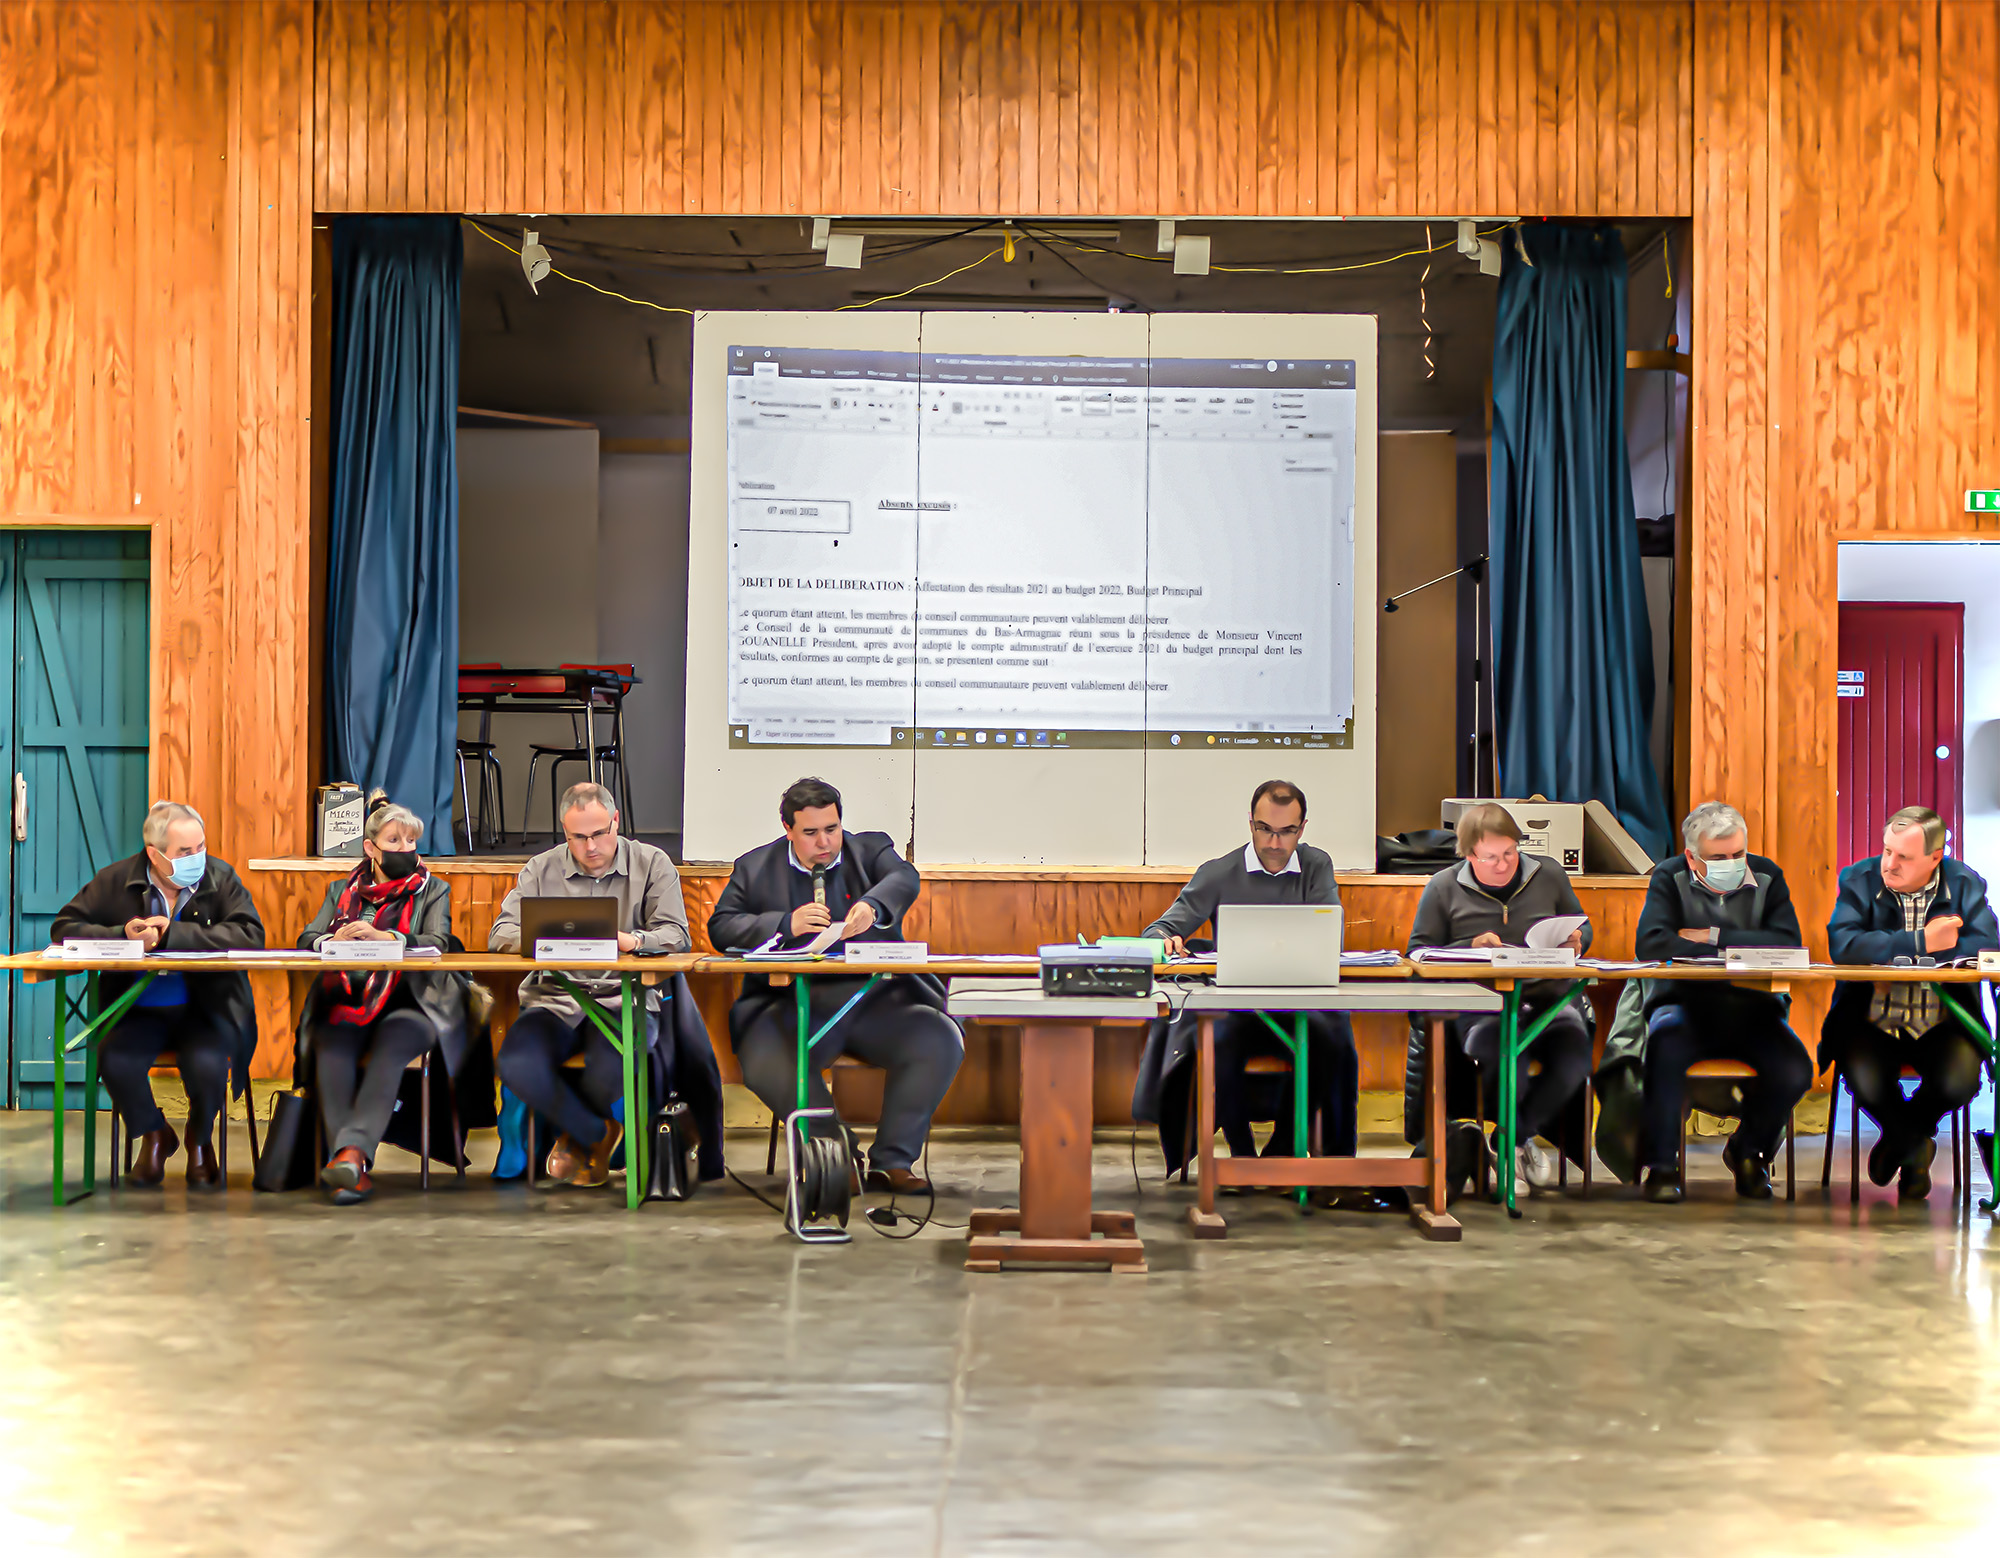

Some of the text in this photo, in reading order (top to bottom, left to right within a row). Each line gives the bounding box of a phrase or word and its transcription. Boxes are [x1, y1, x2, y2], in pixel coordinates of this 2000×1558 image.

[767, 506, 818, 517] 07 avril 2022
[878, 499, 913, 510] Absents
[778, 578, 794, 589] DE
[797, 578, 812, 589] LA
[816, 579, 904, 591] DELIBERATION
[915, 581, 965, 593] Affectation
[969, 583, 983, 593] des
[1027, 584, 1048, 594] 2021
[1052, 586, 1062, 594] au
[1065, 584, 1096, 597] budget
[1127, 585, 1159, 597] Budget
[1162, 585, 1202, 598] Principal
[752, 610, 788, 619] quorum
[791, 608, 813, 618] étant
[851, 609, 863, 619] les
[866, 610, 907, 620] membres
[925, 611, 957, 621] conseil
[960, 613, 1029, 622] communautaire
[1032, 615, 1068, 625] peuvent
[1071, 614, 1125, 624] valablement
[757, 622, 792, 633] Conseil
[800, 623, 810, 633] de
[819, 623, 826, 633] la
[834, 624, 893, 635] communauté
[901, 625, 911, 635] de
[920, 627, 968, 636] communes
[976, 627, 987, 637] du
[995, 626, 1061, 640] Bas-Armagnac
[1100, 630, 1119, 639] sous
[1127, 629, 1135, 639] la
[1198, 630, 1208, 640] de
[1216, 630, 1259, 640] Monsieur
[1267, 630, 1302, 641] Vincent
[958, 641, 966, 650] le
[971, 642, 1004, 653] compte
[1010, 641, 1068, 653] administratif
[1073, 643, 1083, 653] de
[1166, 644, 1177, 654] du
[1183, 644, 1213, 656] budget
[1219, 645, 1258, 657] principal
[1265, 645, 1284, 655] dont
[1290, 645, 1302, 655] les
[781, 652, 830, 662] conformes
[833, 654, 843, 663] au
[846, 655, 880, 665] compte
[883, 654, 893, 664] de
[896, 655, 931, 666] geston,
[935, 656, 944, 665] se
[996, 657, 1029, 666] comme
[1032, 658, 1048, 666] suit
[752, 677, 788, 687] quorum
[791, 676, 812, 685] étant
[850, 676, 863, 686] les
[866, 677, 907, 687] membres
[925, 678, 956, 688] conseil
[960, 680, 1029, 689] communautaire
[1032, 681, 1068, 691] peuvent
[1071, 680, 1125, 690] valablement
[329, 810, 360, 818] MICROS
